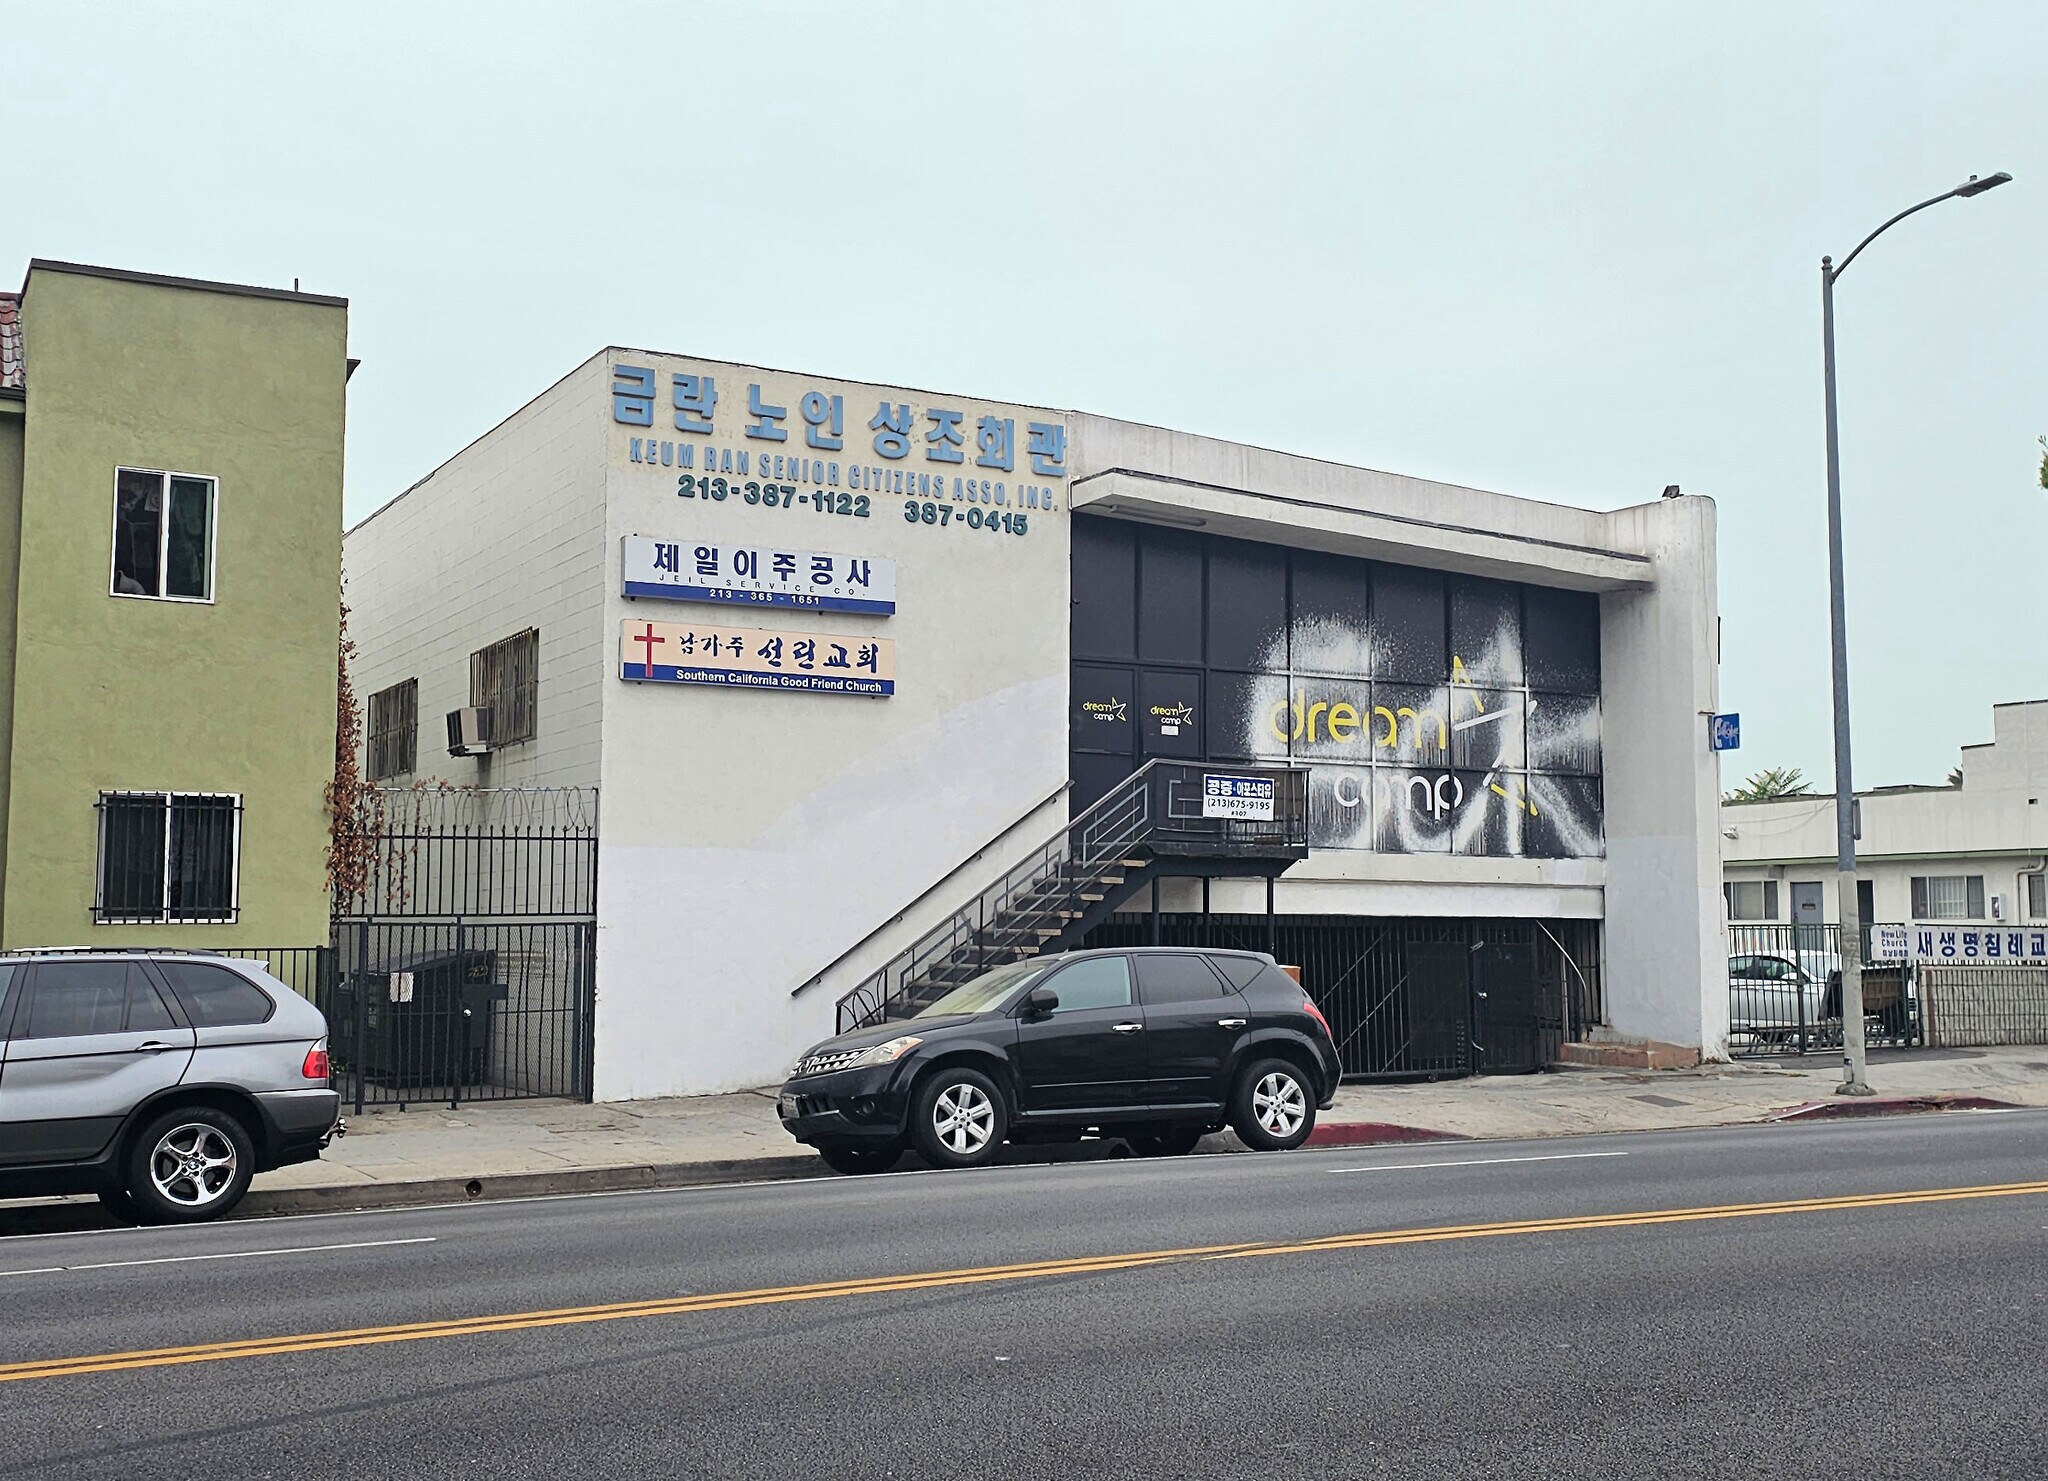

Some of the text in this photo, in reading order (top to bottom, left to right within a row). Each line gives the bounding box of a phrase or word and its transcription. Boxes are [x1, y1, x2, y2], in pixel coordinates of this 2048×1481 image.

[612, 364, 1067, 477] 금란 노인 상조회관
[629, 437, 694, 469] KEUM
[704, 446, 749, 476] RAN
[758, 453, 840, 487] SENIOR
[847, 464, 945, 499] CITIZENS
[1017, 484, 1059, 511] INC.
[677, 474, 1029, 536] 213-387-1122 387-0415
[653, 543, 871, 587] 제일이주공사
[659, 574, 706, 585] JEIL
[725, 579, 815, 593] SERVICE
[679, 632, 879, 674] 남가주 선린교회
[676, 669, 882, 693] Southern California Good Friend Church
[1082, 702, 1112, 712] dream
[1093, 713, 1115, 722] camp
[1150, 706, 1179, 716] dream
[1269, 688, 1446, 750] dream
[1161, 717, 1181, 726] camp
[1207, 798, 1270, 810] (213)675-9195
